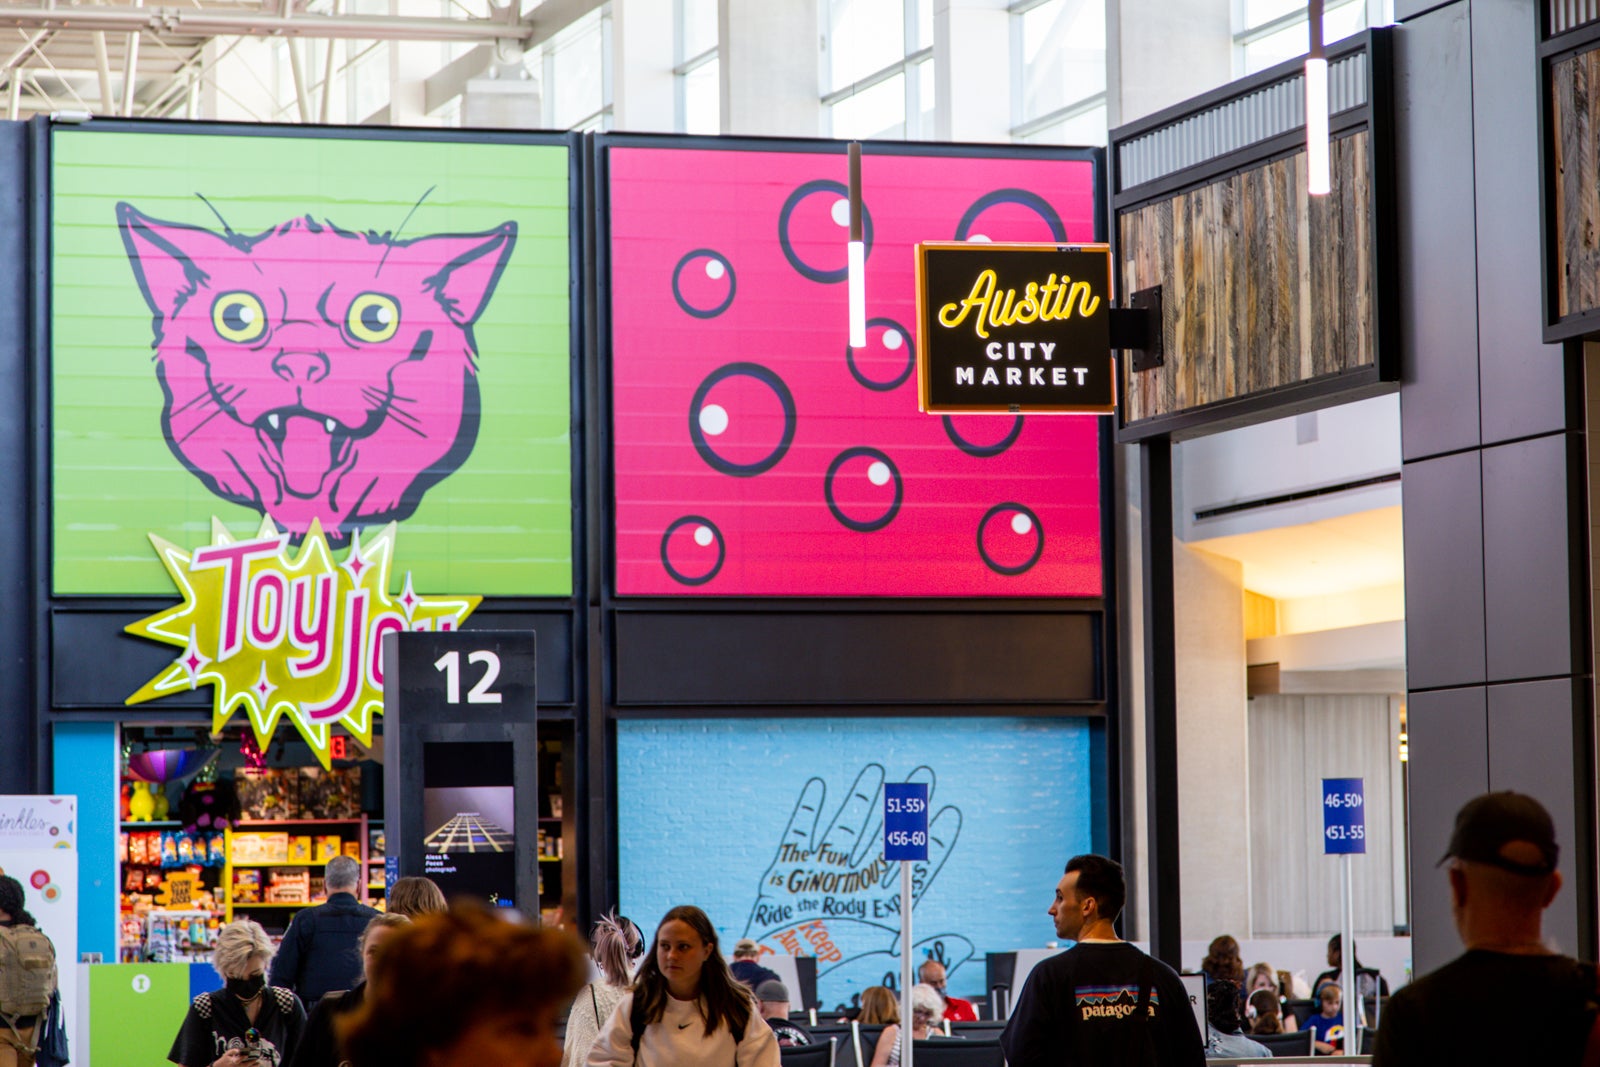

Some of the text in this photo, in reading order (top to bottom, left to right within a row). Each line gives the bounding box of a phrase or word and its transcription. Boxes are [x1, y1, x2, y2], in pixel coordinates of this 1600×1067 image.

[938, 269, 1100, 339] Austin
[985, 342, 1056, 361] CITY
[955, 367, 1089, 386] MARKET
[300, 588, 459, 725] Jo
[433, 649, 502, 704] 12
[887, 798, 920, 813] 51-55
[1324, 793, 1359, 808] 46-50
[893, 831, 926, 846] 56-60
[1331, 825, 1365, 840] 51-55
[781, 843, 809, 862] The
[769, 871, 784, 886] is
[755, 904, 793, 926] Ride
[798, 898, 819, 912] the
[822, 897, 866, 918] Rody
[797, 918, 842, 963] Keep
